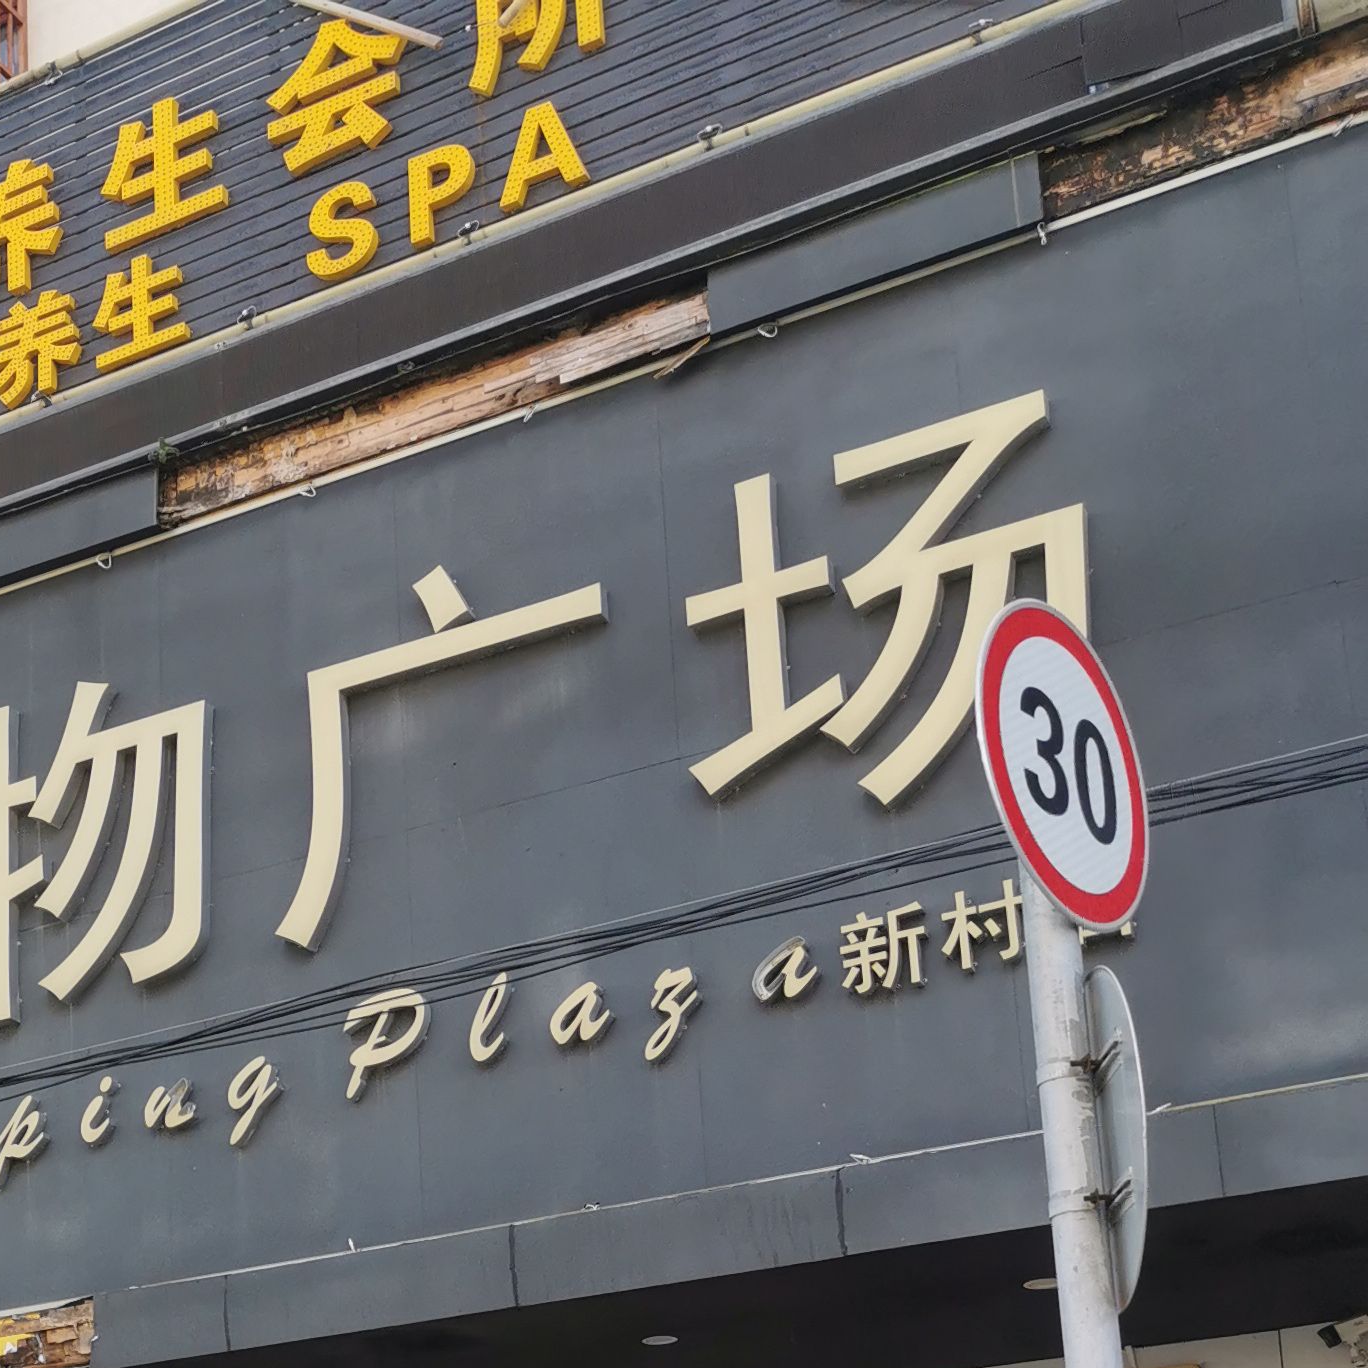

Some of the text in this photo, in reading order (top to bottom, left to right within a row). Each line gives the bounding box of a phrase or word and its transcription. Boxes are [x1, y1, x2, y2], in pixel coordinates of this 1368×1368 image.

[306, 100, 592, 282] SPA
[1018, 686, 1118, 847] 30
[343, 935, 820, 1103] Plaza
